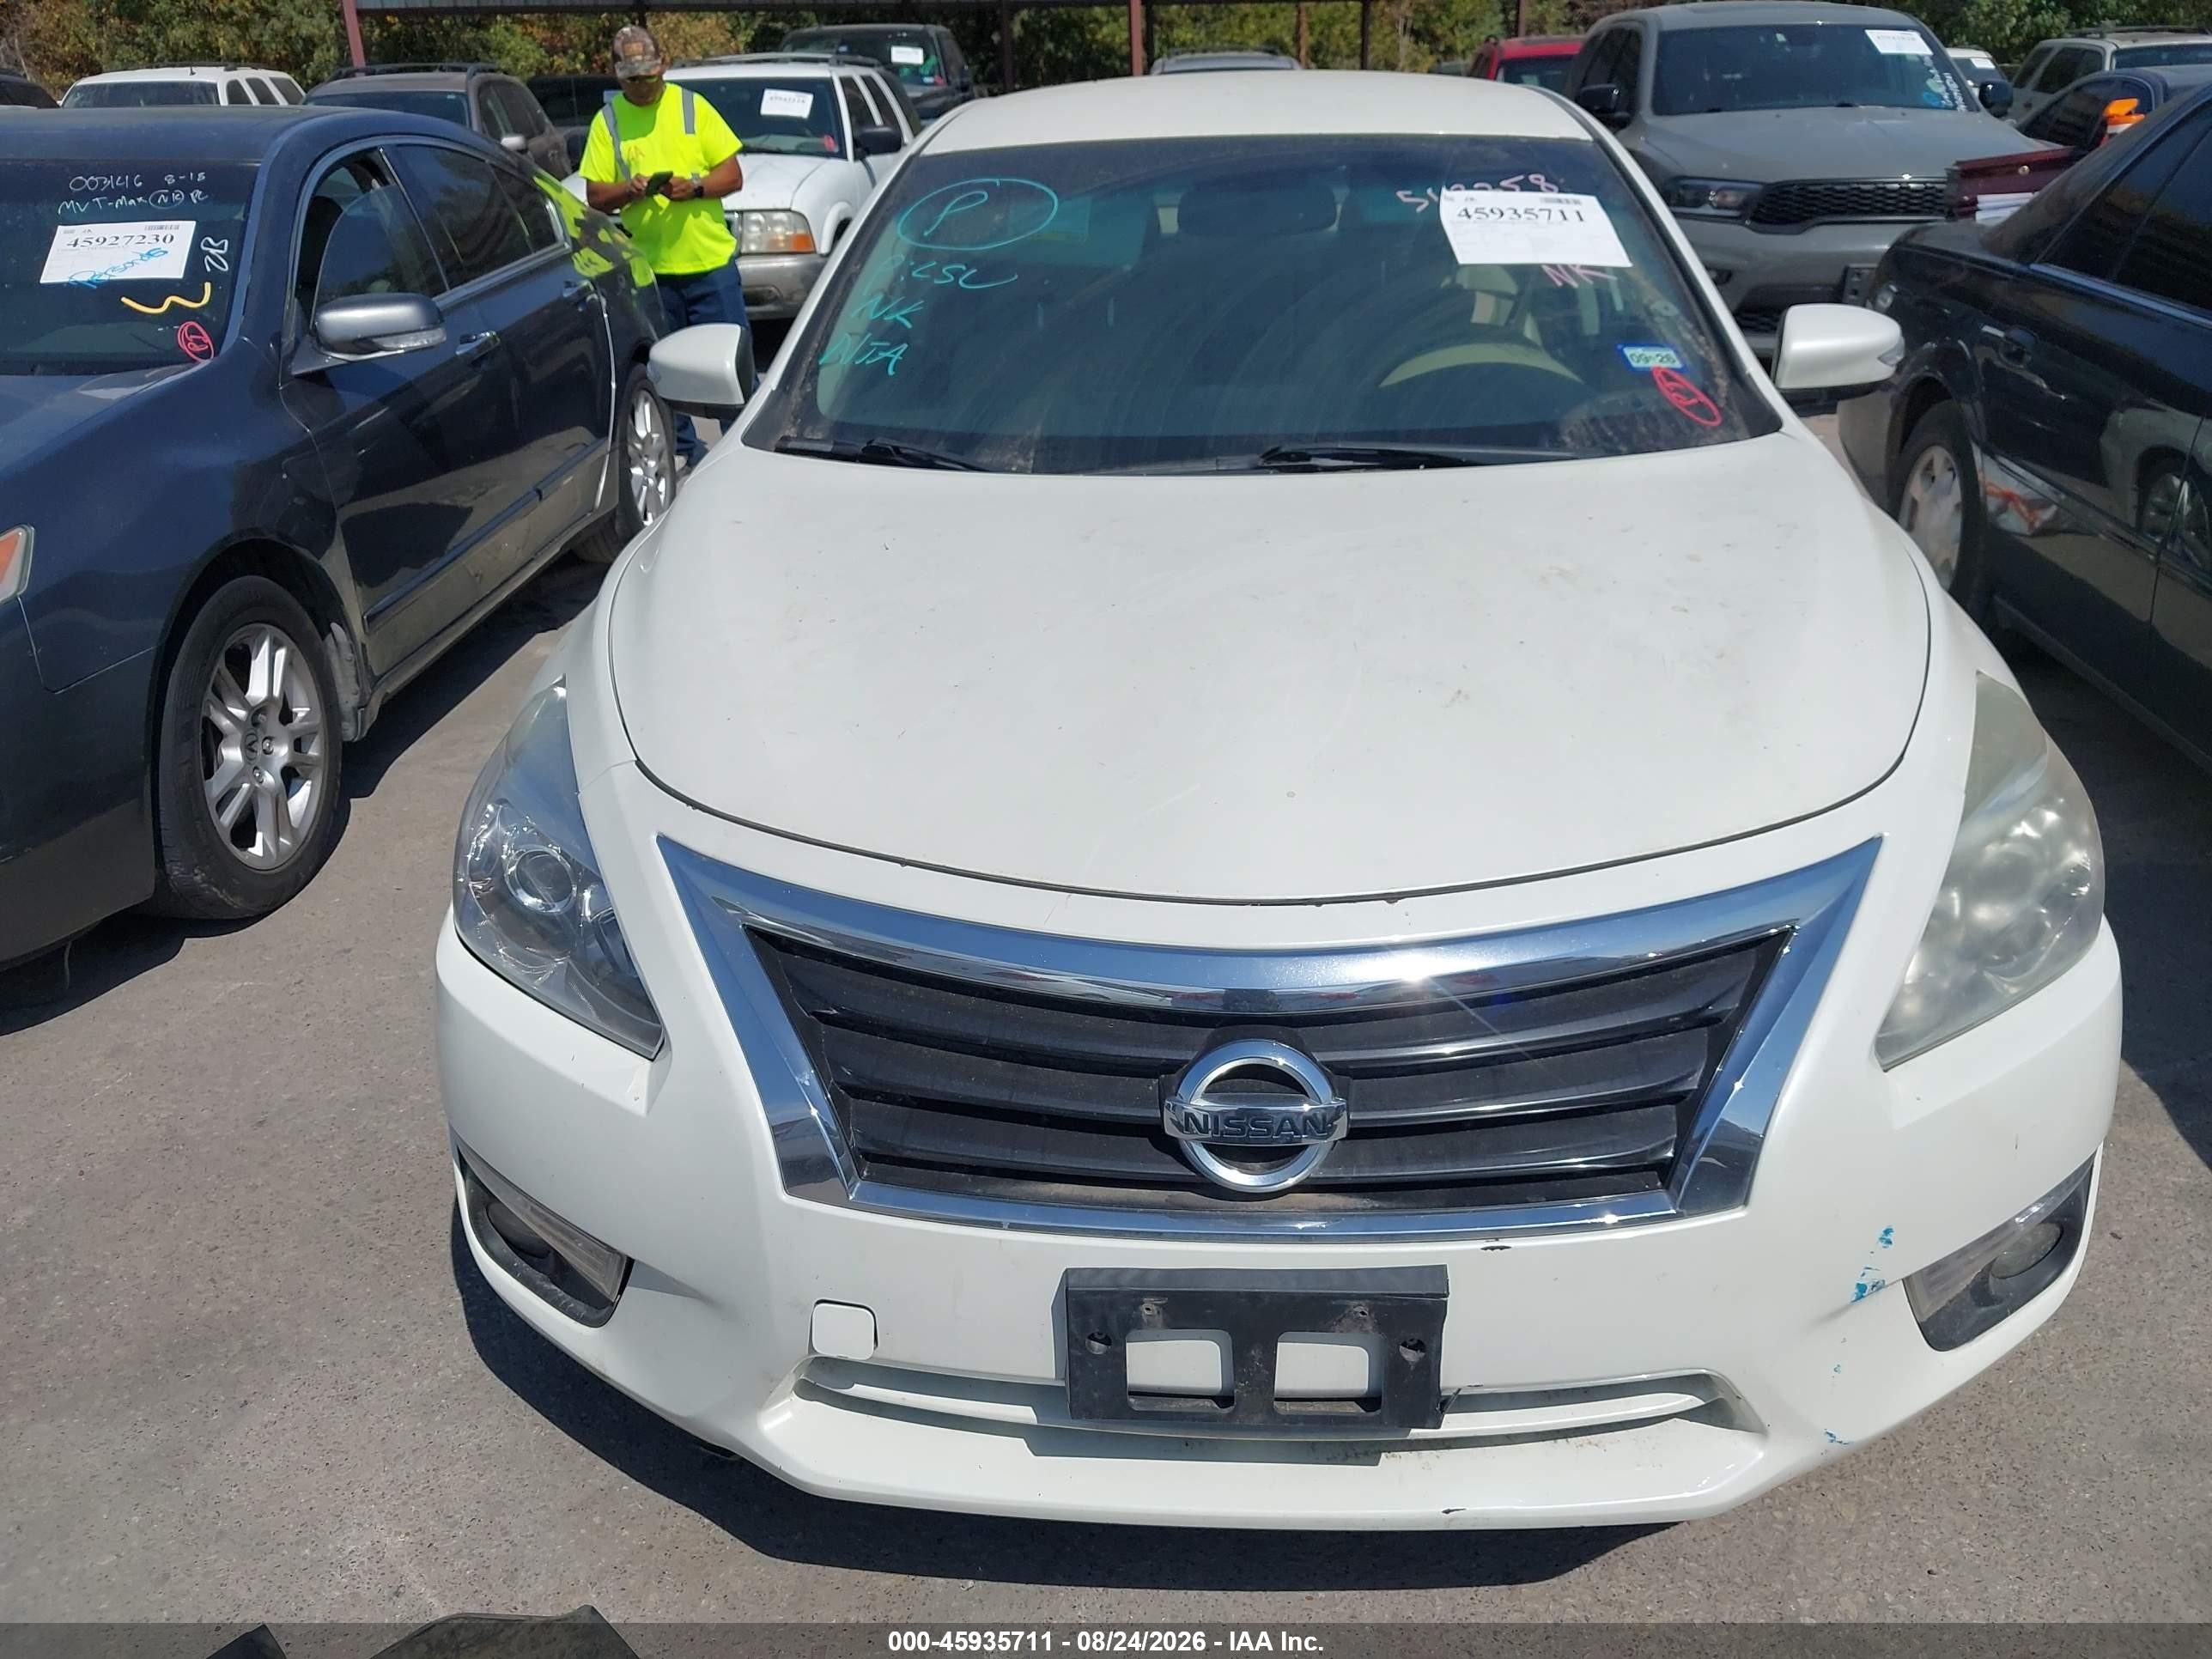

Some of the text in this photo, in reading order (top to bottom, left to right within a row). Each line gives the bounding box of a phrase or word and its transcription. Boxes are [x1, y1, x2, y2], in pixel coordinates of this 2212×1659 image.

[1457, 206, 1585, 222] 45935711
[67, 233, 175, 248] 45927230
[851, 294, 925, 329] NK
[1182, 1111, 1330, 1139] NISSAN
